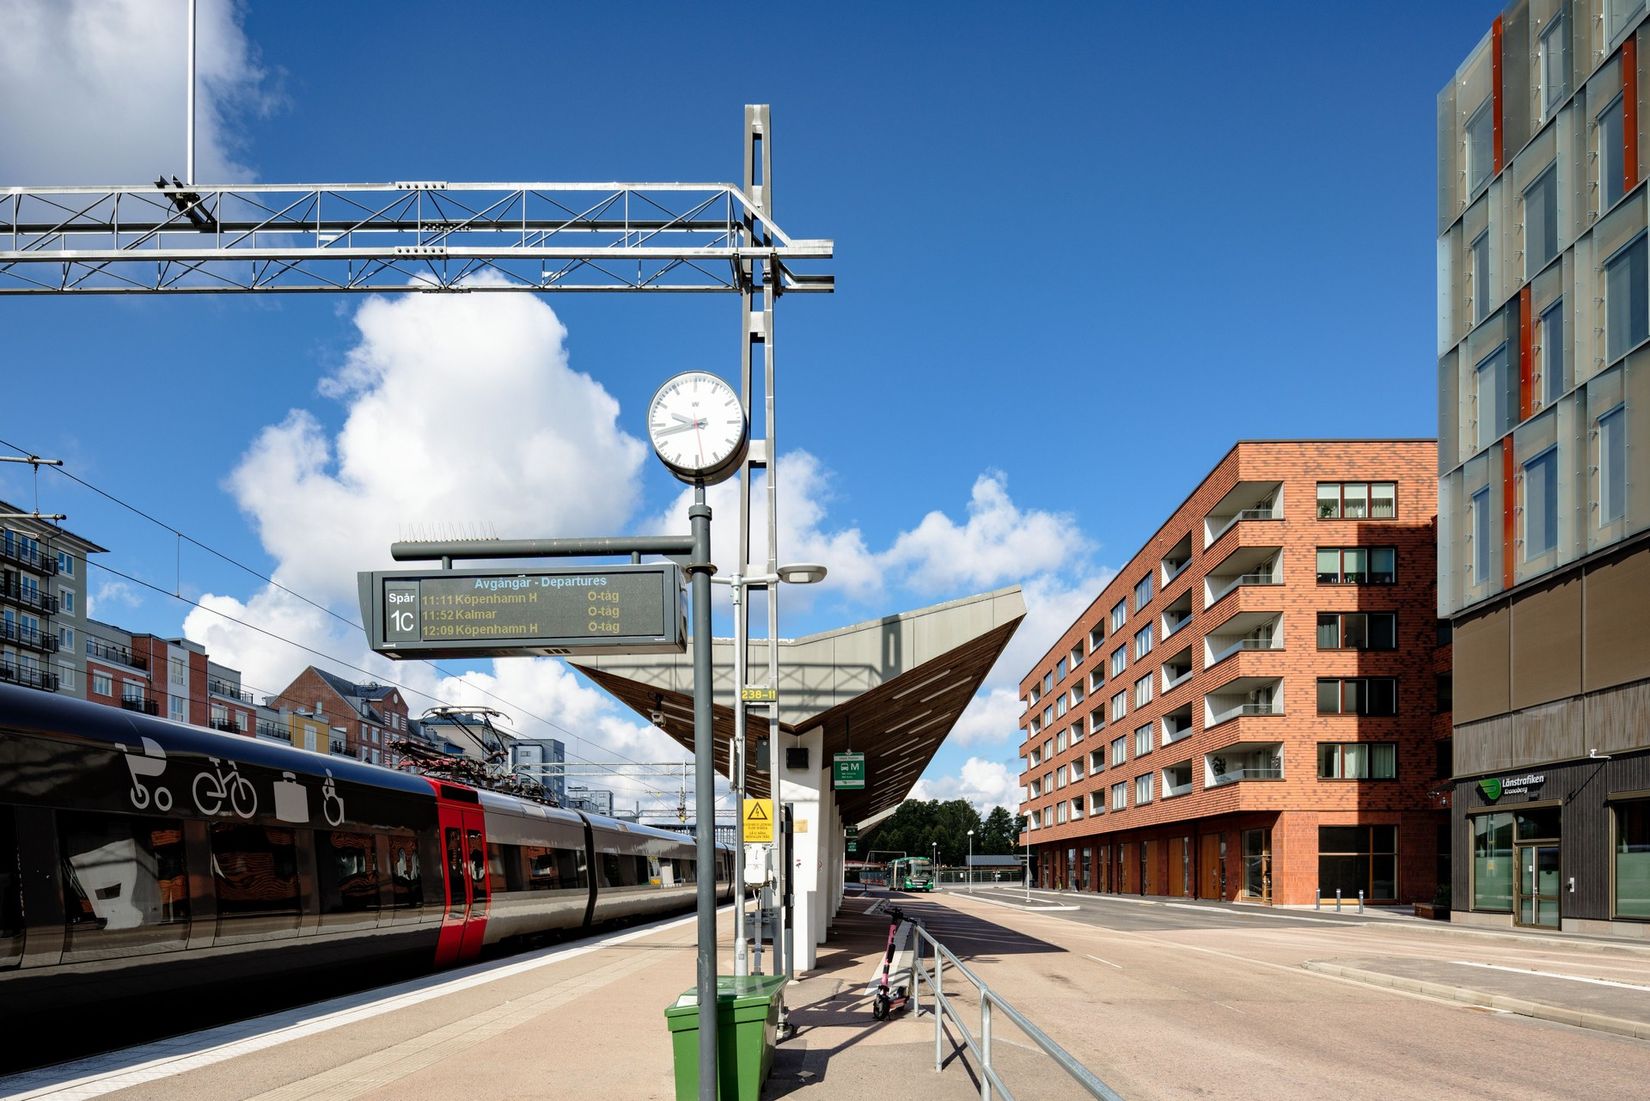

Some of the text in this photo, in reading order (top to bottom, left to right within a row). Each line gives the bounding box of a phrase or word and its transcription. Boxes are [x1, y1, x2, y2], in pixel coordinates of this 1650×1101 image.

[475, 577, 531, 591] Avgångar
[541, 576, 607, 589] Departures
[389, 593, 415, 605] Spår
[423, 594, 453, 605] 11:11
[455, 593, 526, 606] Köpenhamn
[529, 592, 538, 603] H
[391, 610, 414, 632] 1C
[423, 610, 454, 621] 11:52
[455, 609, 496, 620] Kalmar
[423, 625, 454, 637] 12:09
[455, 624, 527, 638] Köpenhamn
[529, 623, 538, 633] H
[742, 690, 776, 700] 238-11
[850, 763, 859, 771] M
[1502, 774, 1544, 787] Länstrafiken
